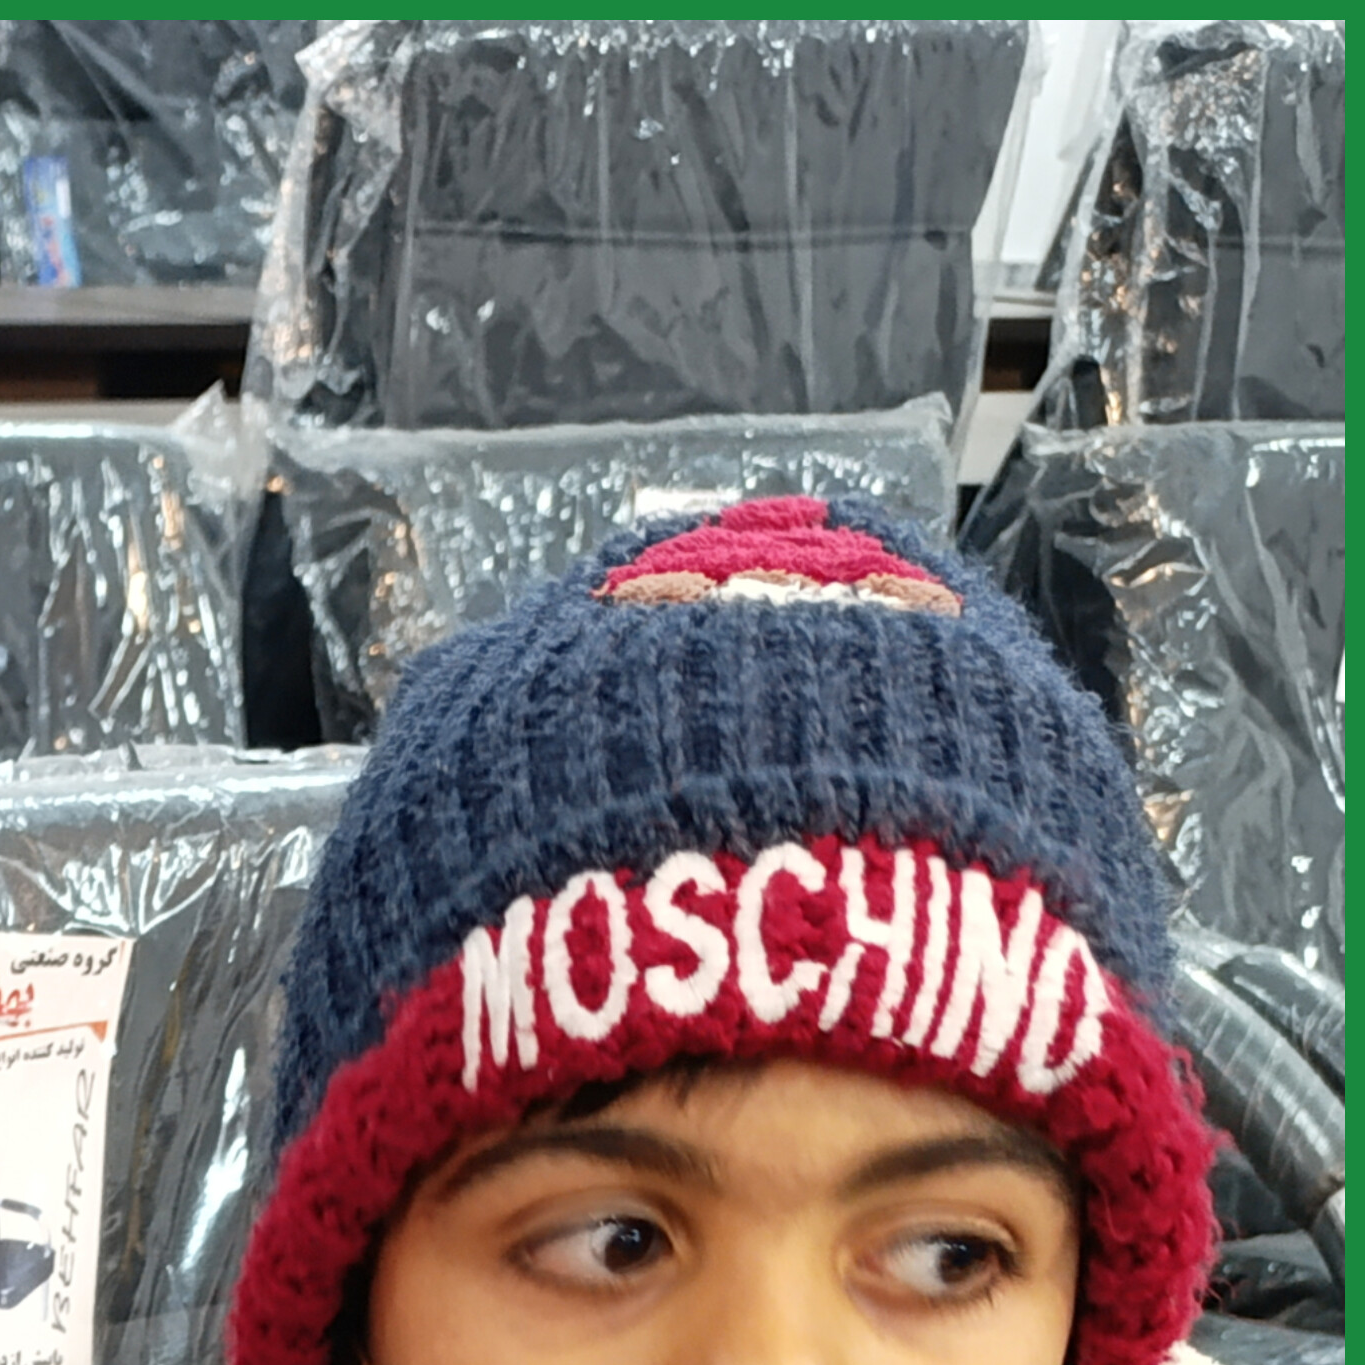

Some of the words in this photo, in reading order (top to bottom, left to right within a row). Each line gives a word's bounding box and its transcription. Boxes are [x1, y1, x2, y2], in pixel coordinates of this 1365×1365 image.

[10, 947, 69, 975] صنعتی
[461, 842, 1115, 1093] MOSCHINO
[51, 1068, 96, 1334] BEHFAR
